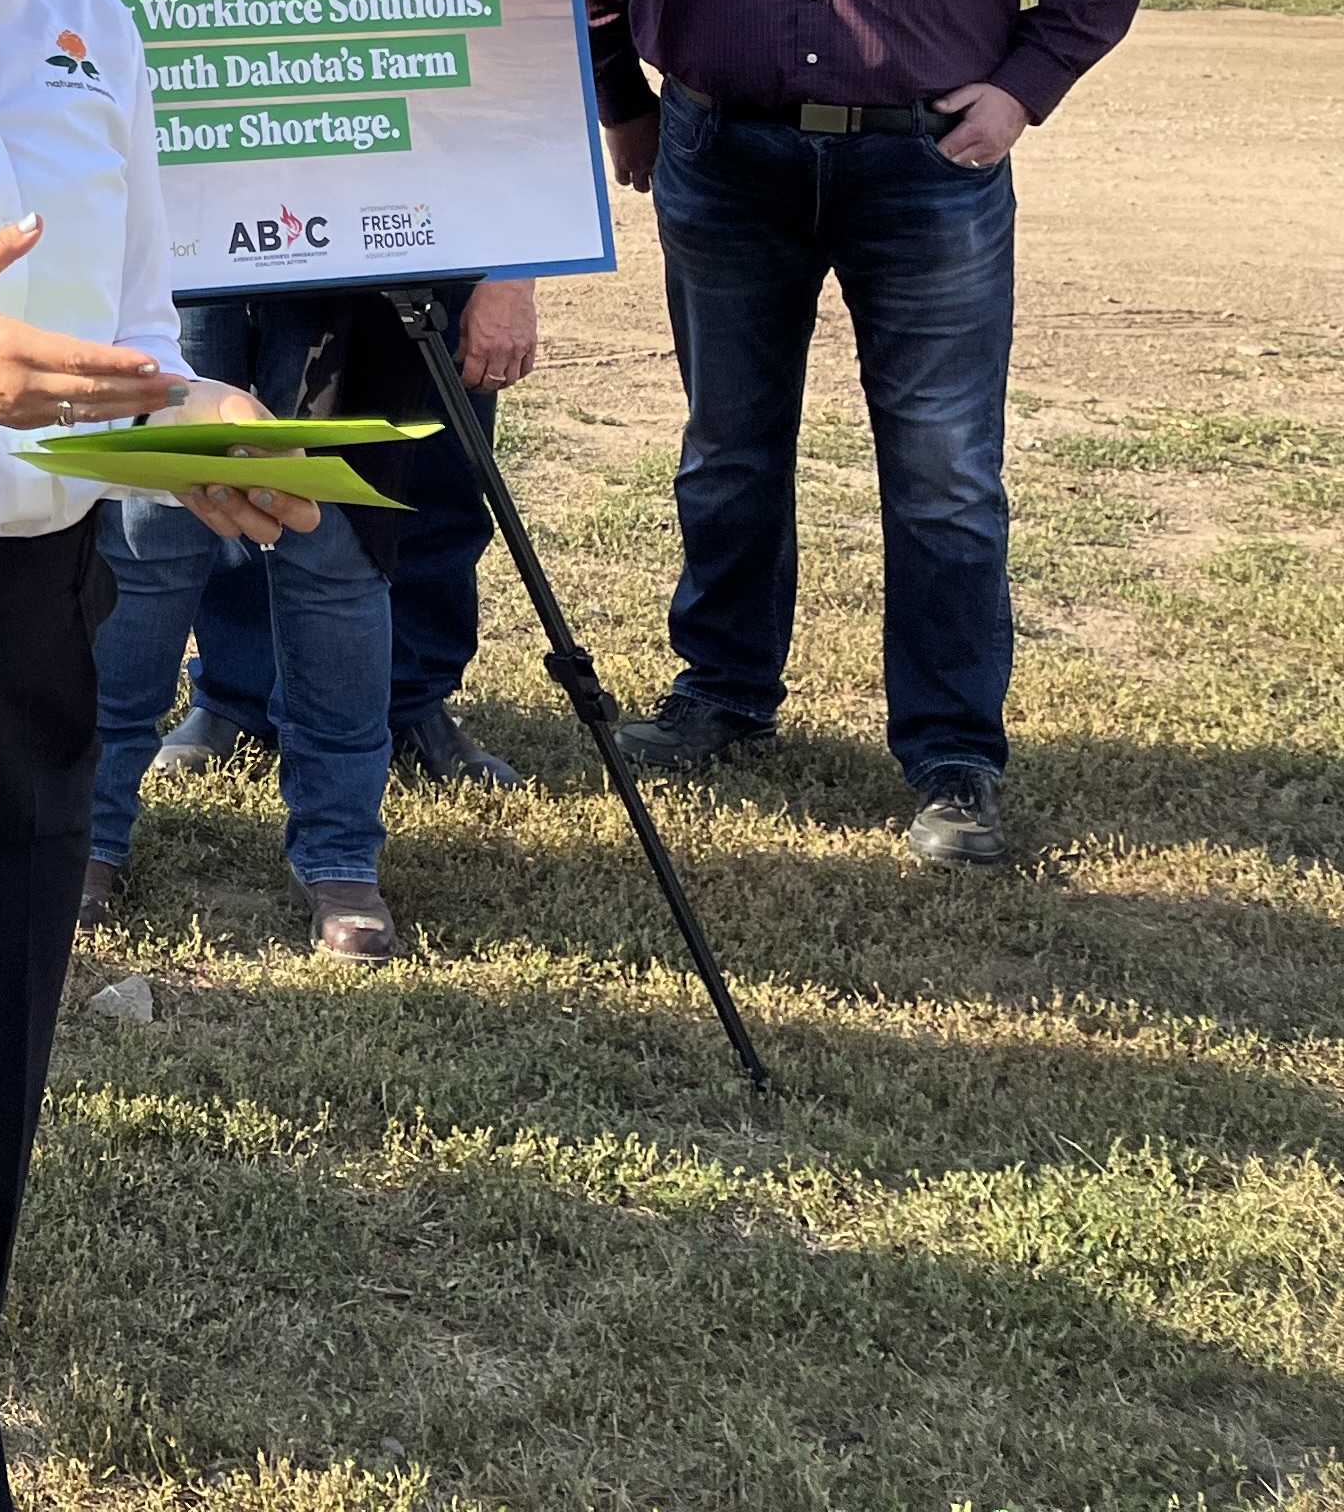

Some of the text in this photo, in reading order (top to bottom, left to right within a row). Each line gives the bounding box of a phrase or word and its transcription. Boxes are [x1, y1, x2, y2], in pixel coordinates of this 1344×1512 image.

[146, 47, 457, 92] outh Dakota's Farm
[155, 110, 400, 152] abor Shortage.
[362, 214, 412, 232] FRESH
[363, 230, 435, 250] PRODUCE
